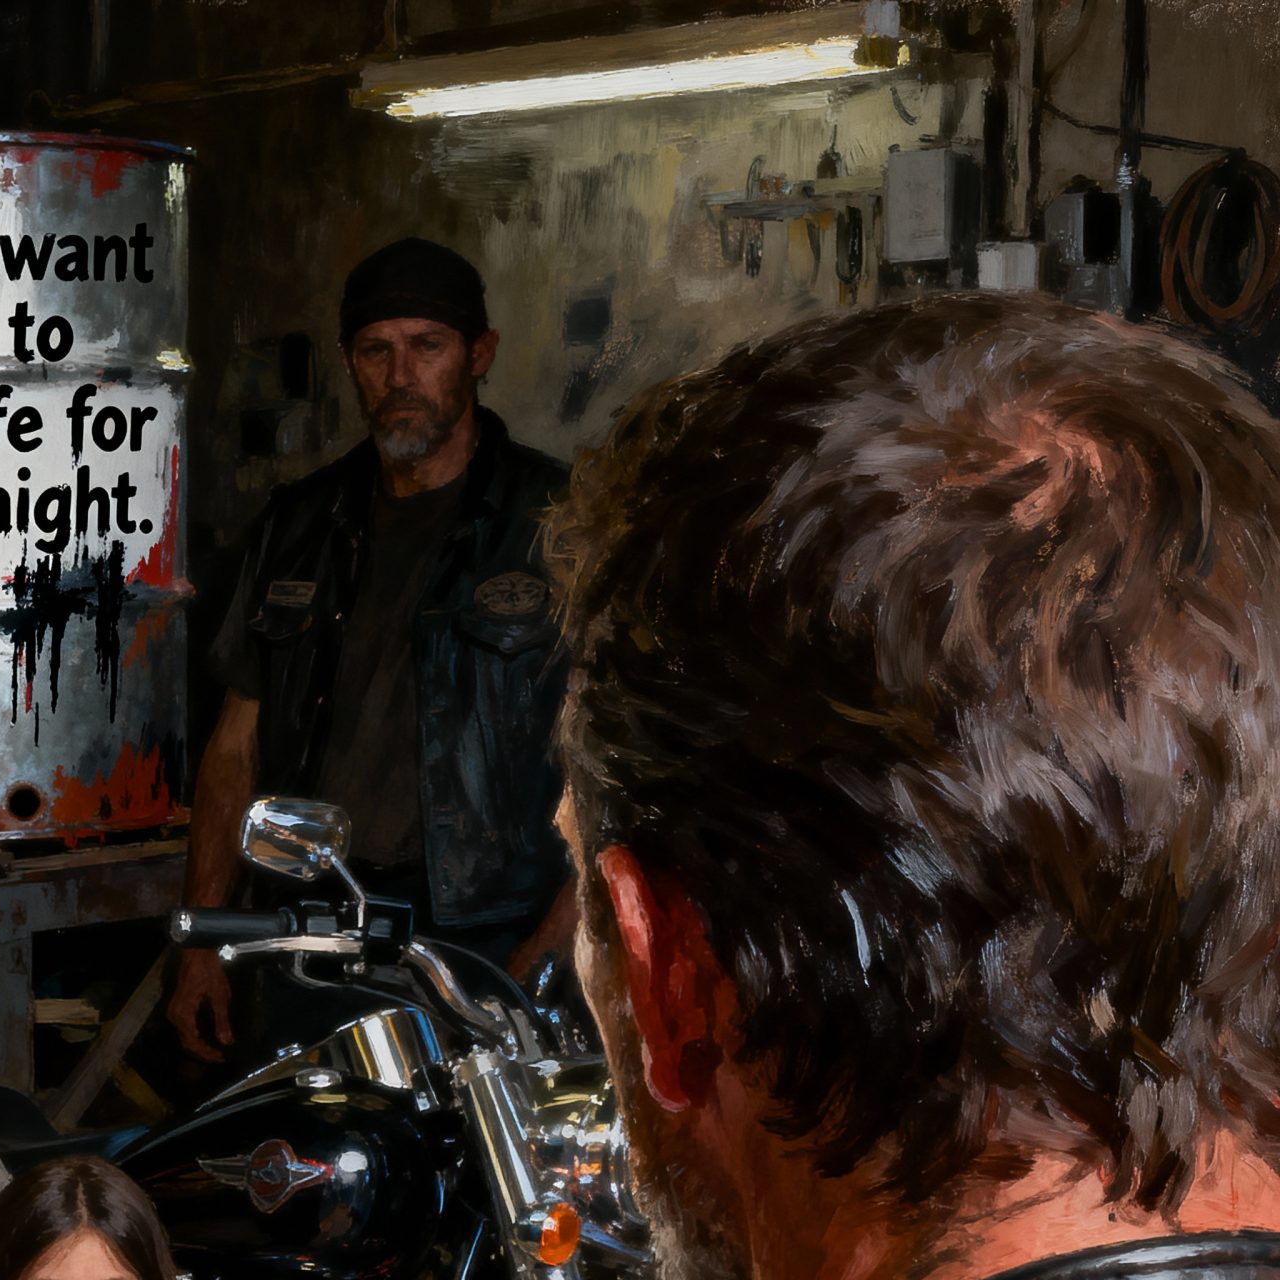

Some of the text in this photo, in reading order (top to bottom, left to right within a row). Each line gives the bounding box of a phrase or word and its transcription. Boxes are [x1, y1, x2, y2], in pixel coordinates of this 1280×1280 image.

[0, 221, 154, 284] want
[7, 300, 74, 364] to
[66, 383, 158, 467] for
